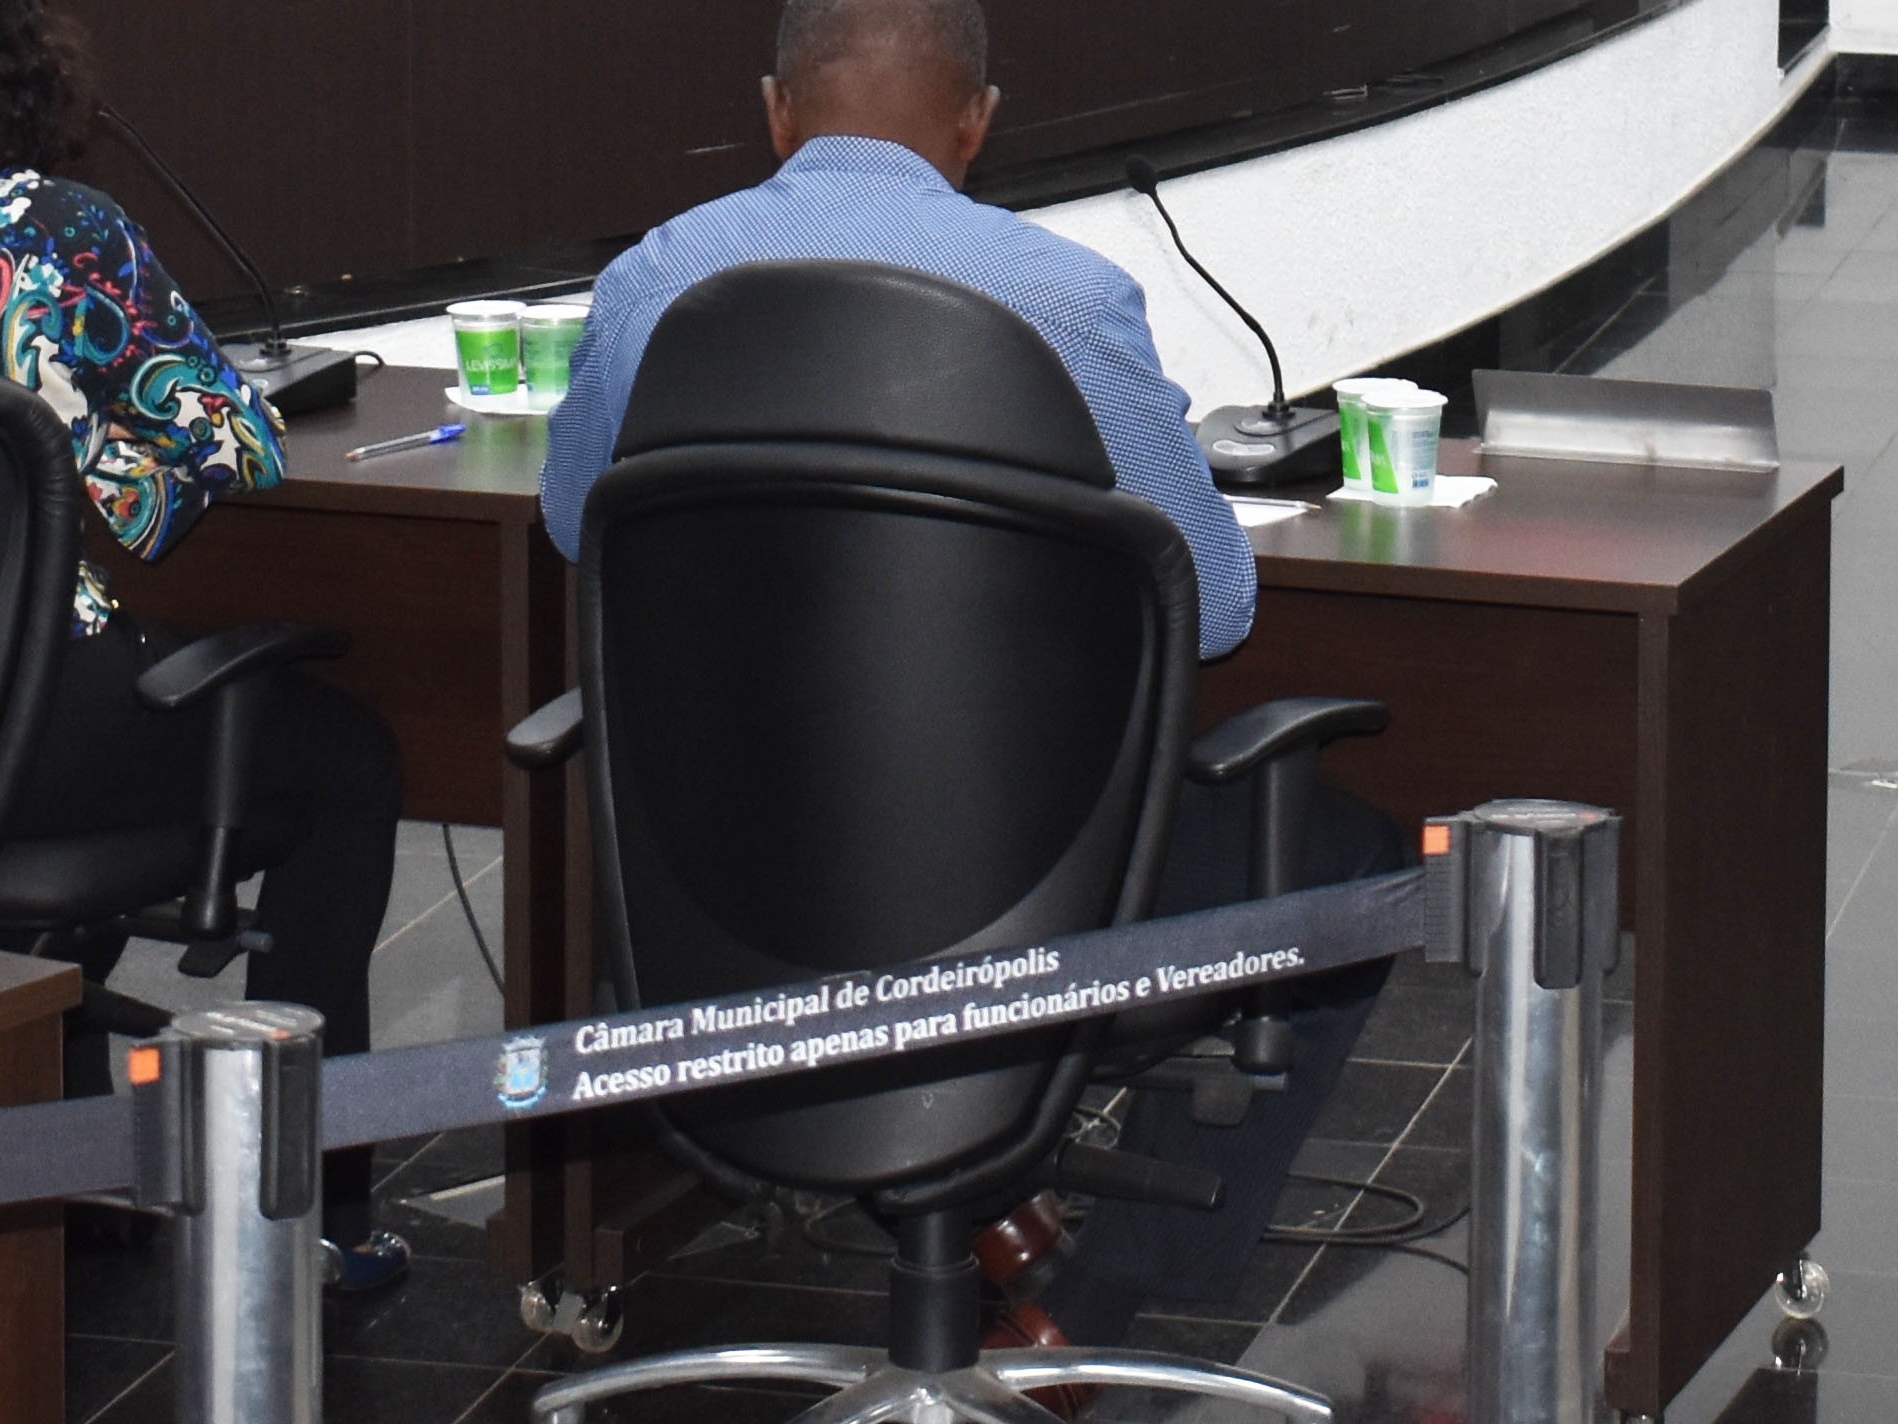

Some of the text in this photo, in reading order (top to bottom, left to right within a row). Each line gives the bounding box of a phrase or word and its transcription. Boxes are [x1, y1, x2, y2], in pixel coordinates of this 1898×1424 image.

[571, 944, 1306, 1101] Acesso restrito apenas para funcionários e Vereadores.
[575, 945, 1061, 1056] Câmara Municipal de Cordeirópolis
